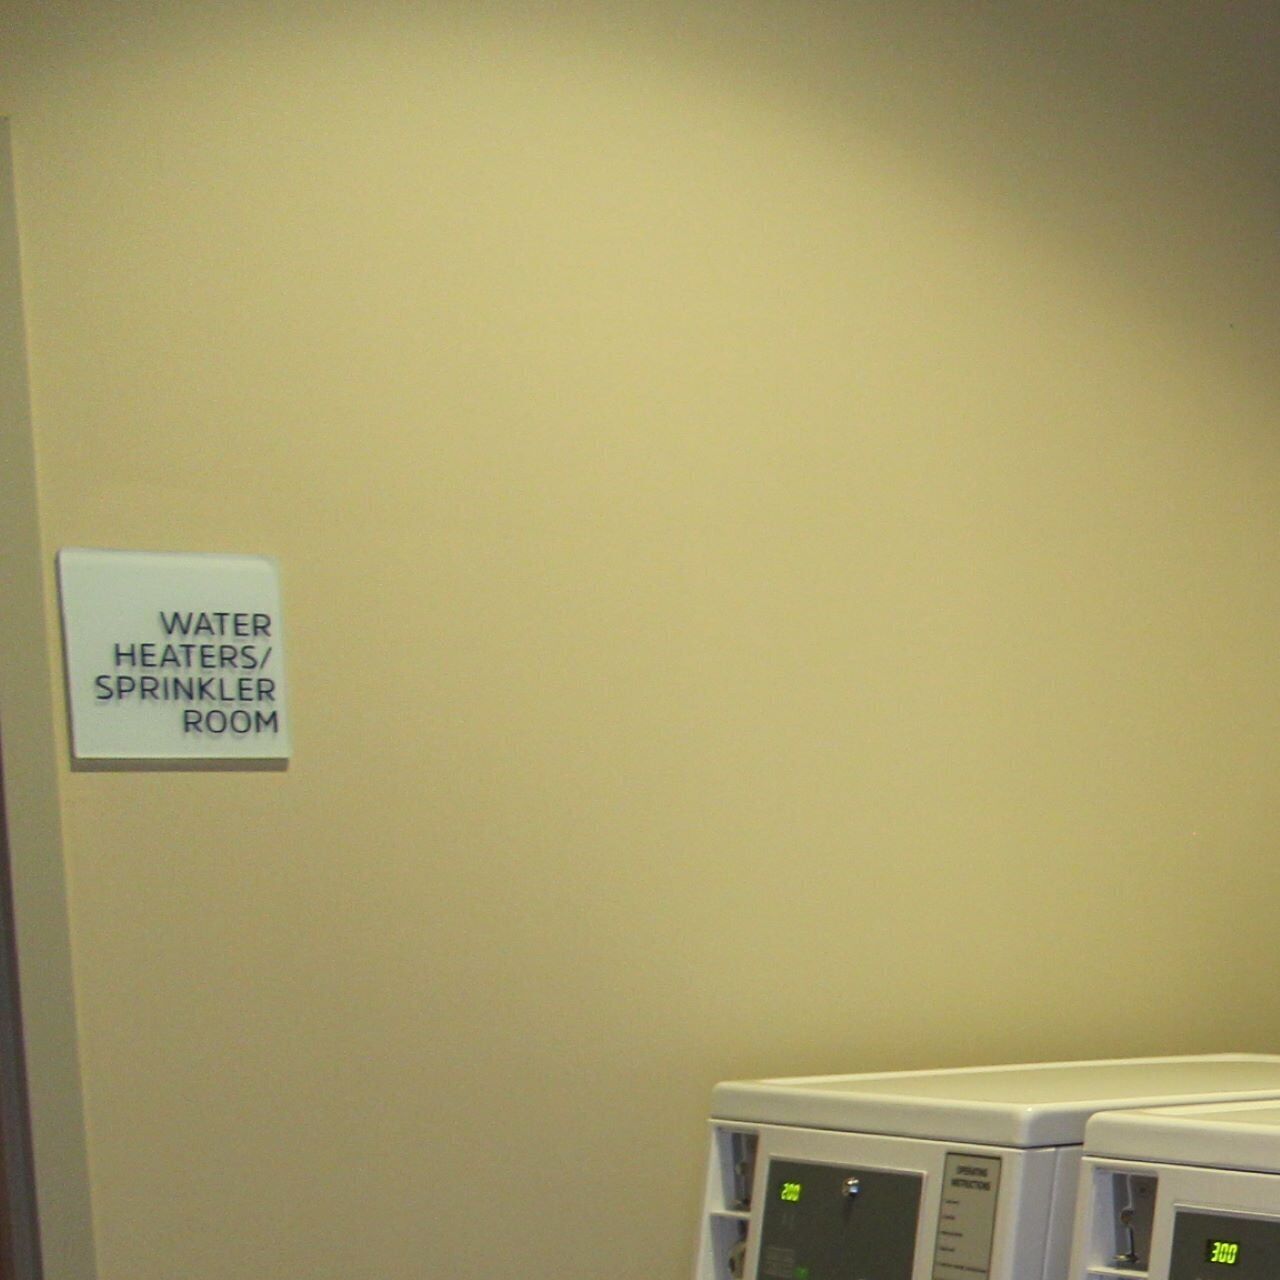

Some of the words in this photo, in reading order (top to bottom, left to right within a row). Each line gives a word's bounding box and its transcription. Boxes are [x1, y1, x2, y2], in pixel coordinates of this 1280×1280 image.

[160, 611, 272, 638] WATER
[114, 643, 273, 670] HEATERS/
[95, 675, 276, 702] SPRINKLER
[183, 709, 279, 734] ROOM
[1210, 1242, 1239, 1264] 300
